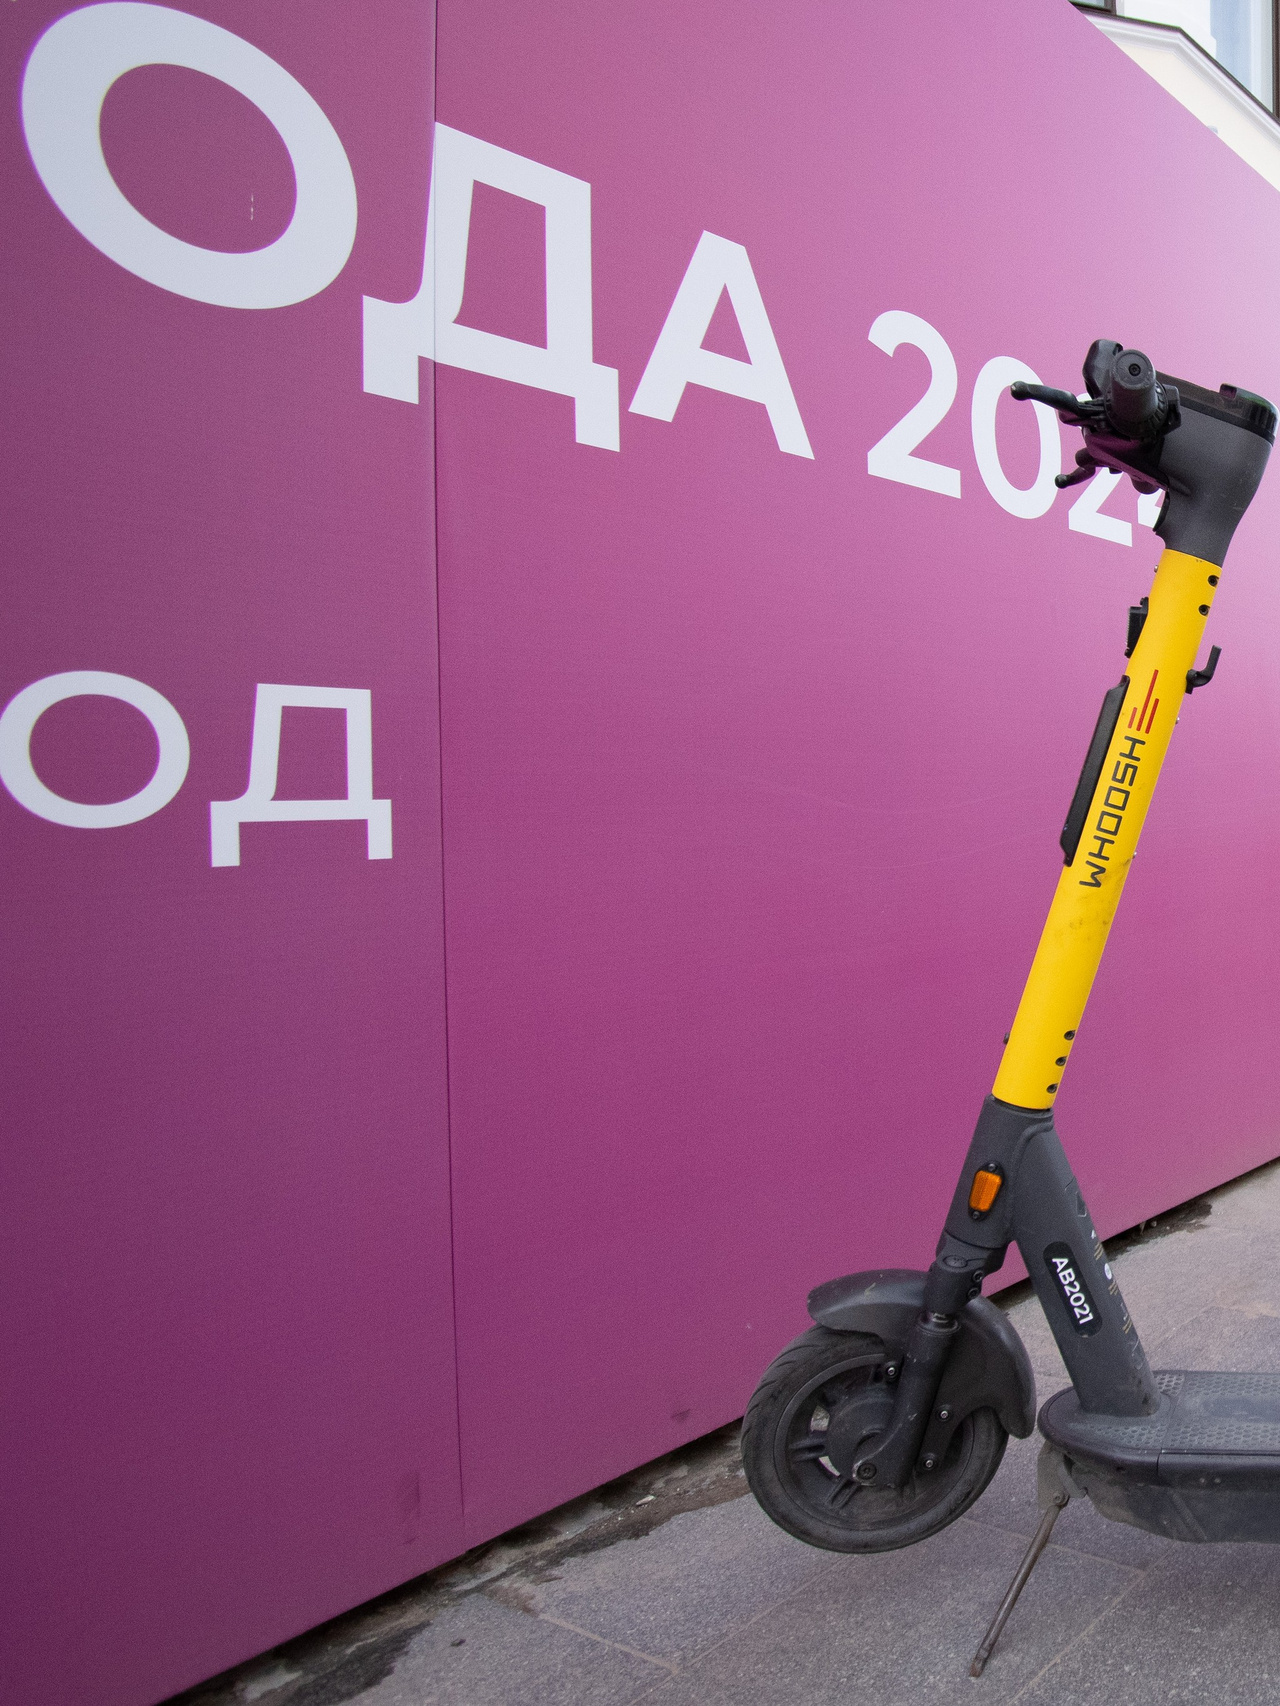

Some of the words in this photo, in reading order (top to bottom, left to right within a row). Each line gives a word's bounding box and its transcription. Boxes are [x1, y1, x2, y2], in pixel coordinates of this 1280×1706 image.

[20, 1, 815, 460] ОДА
[867, 309, 1166, 547] 202
[0, 670, 393, 867] ОД
[1079, 735, 1146, 888] WHOOSH
[1051, 1258, 1094, 1325] AB2021
